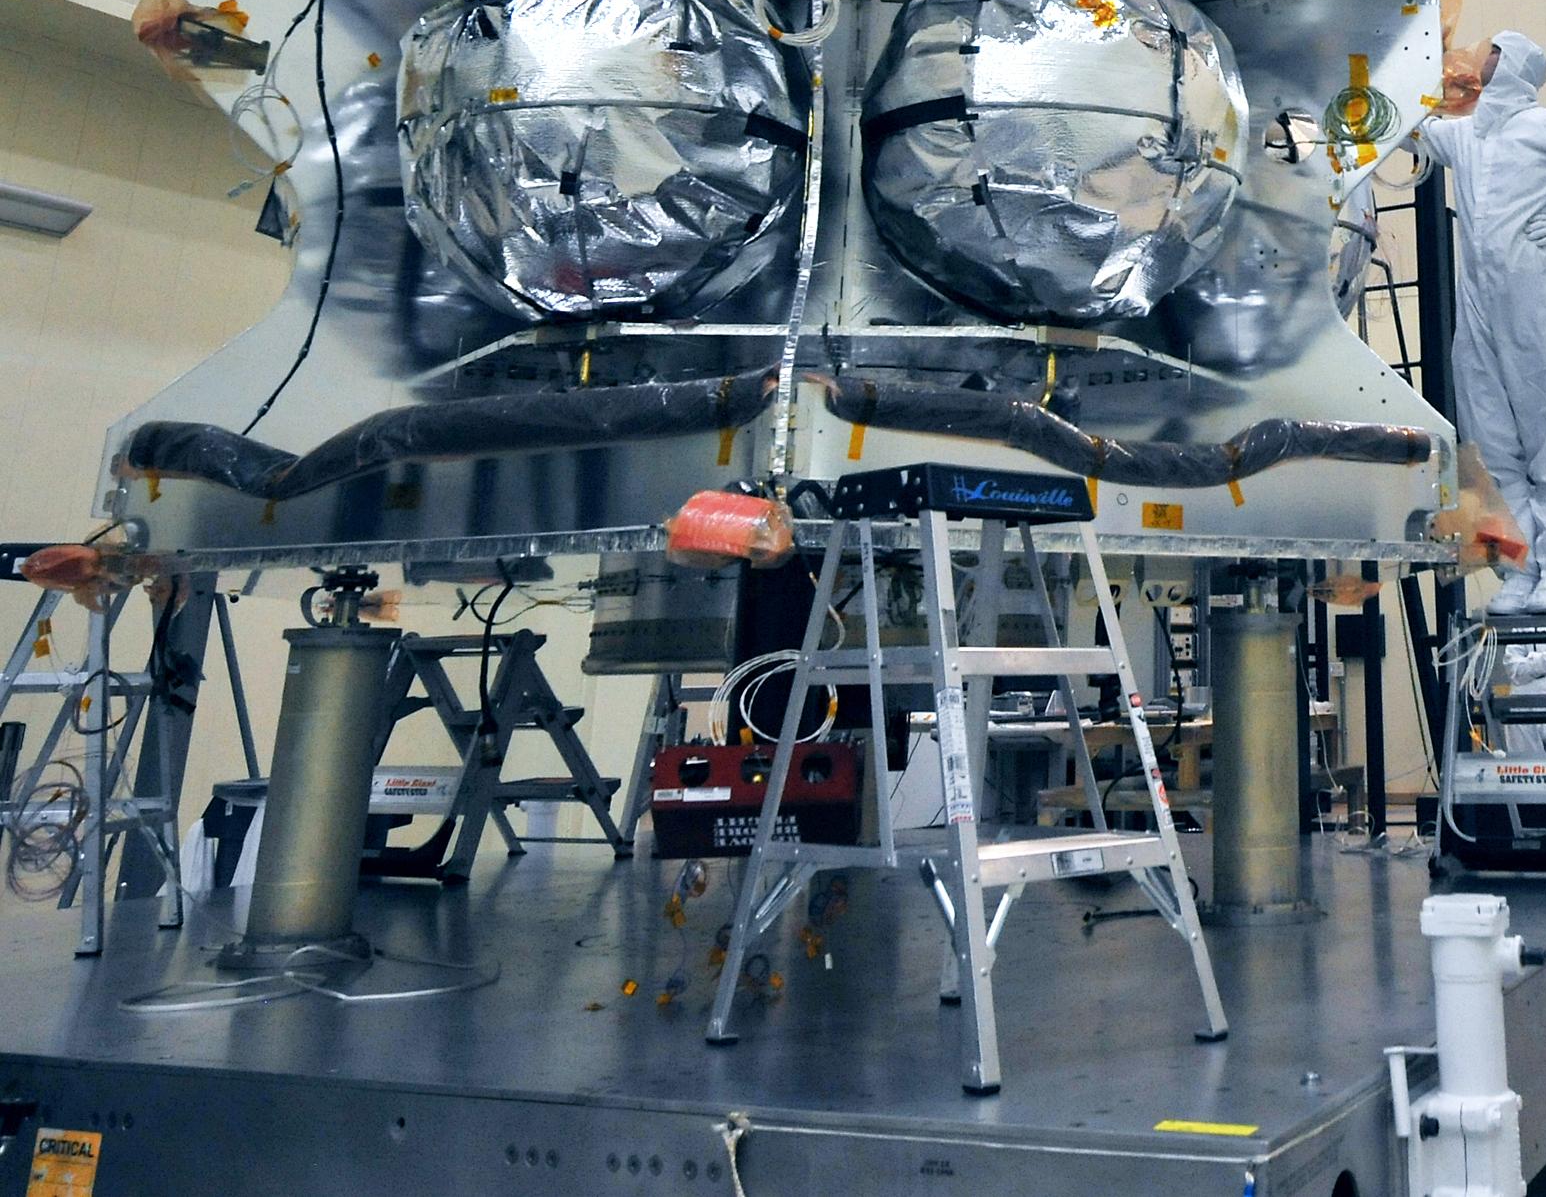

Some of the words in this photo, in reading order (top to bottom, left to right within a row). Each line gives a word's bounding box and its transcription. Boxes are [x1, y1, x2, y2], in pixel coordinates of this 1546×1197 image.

[965, 479, 1074, 507] Louisville
[1496, 765, 1529, 774] Little
[1499, 775, 1534, 784] SAFETY
[39, 1137, 95, 1158] CRITICAL
